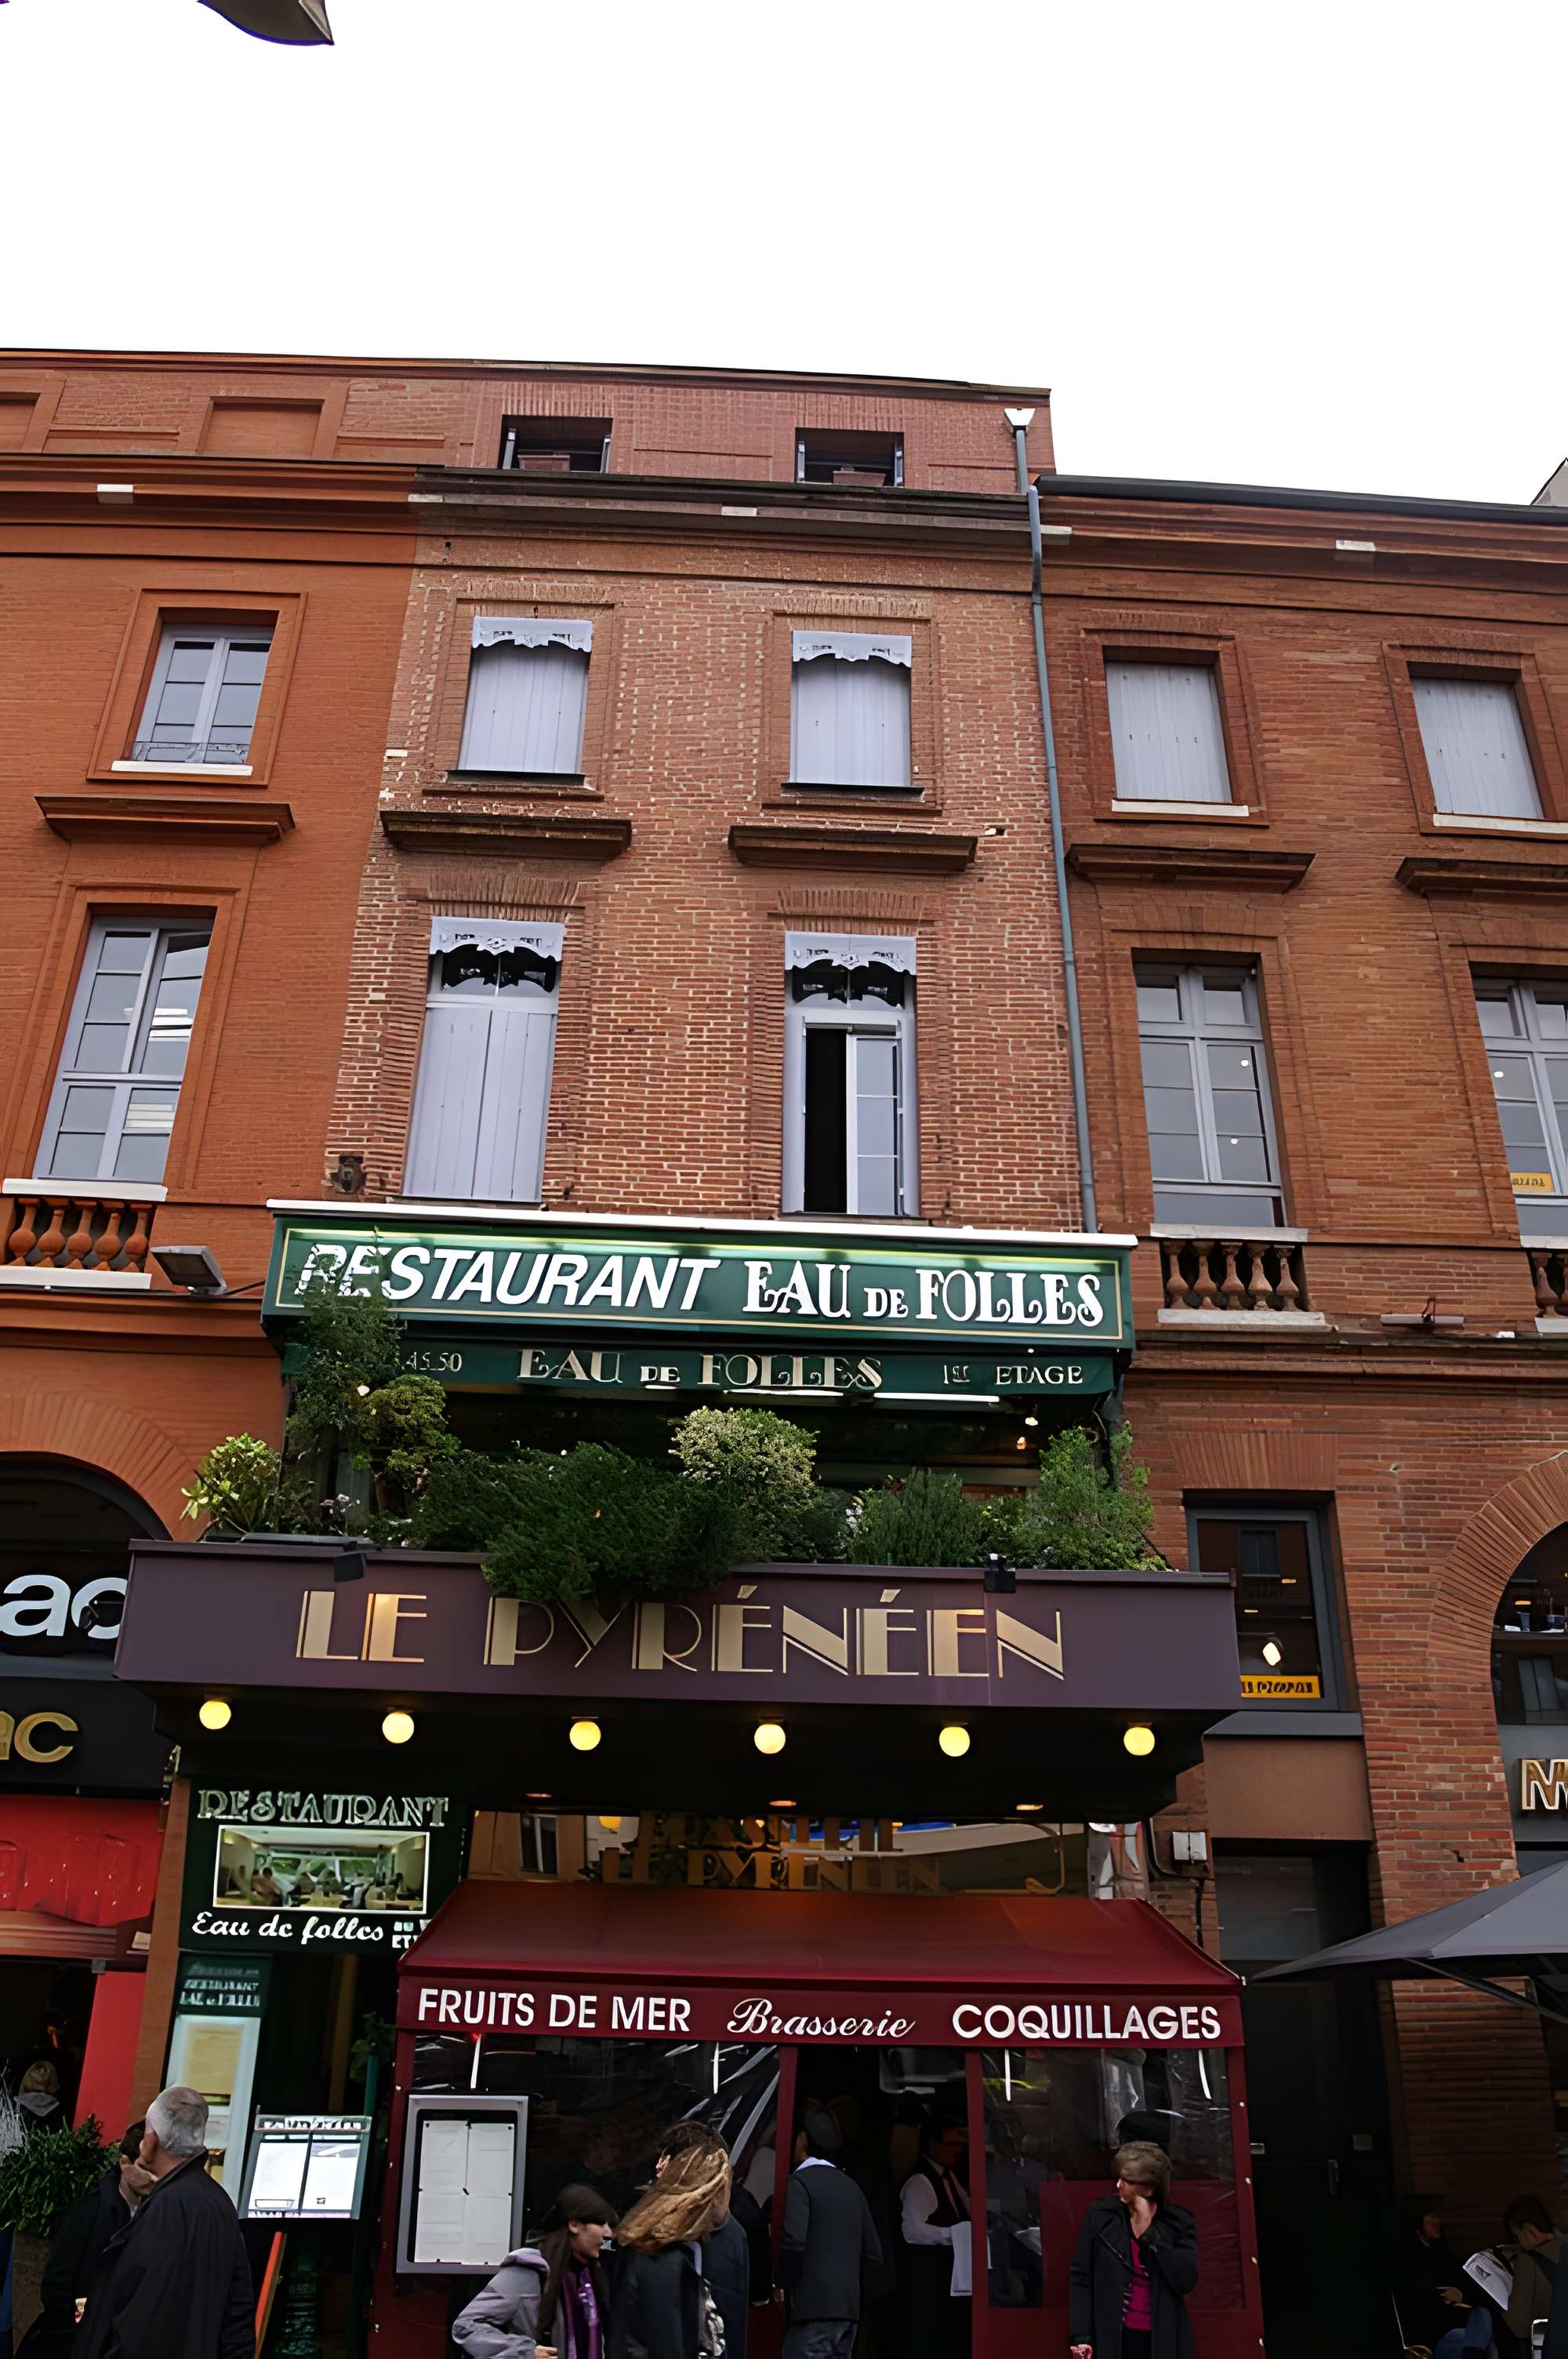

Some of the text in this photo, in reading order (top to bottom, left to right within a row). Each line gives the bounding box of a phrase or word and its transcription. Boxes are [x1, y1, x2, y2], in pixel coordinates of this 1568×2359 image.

[295, 1244, 1104, 1327] RESTAURANT EAU DE FOLLES
[516, 1349, 882, 1390] EAU DE FOLLES
[994, 1366, 1083, 1384] ETAGE
[295, 1584, 1065, 1681] LE PYRÉNÉEN
[197, 1789, 449, 1826] RESTAURANT
[191, 1911, 250, 1936] Eau
[258, 1914, 293, 1939] de
[300, 1916, 384, 1945] folles
[417, 1988, 691, 2031] FRUITS DE MER
[727, 1997, 916, 2037] Brasserie
[952, 2004, 1221, 2040] COQUILLAGES
